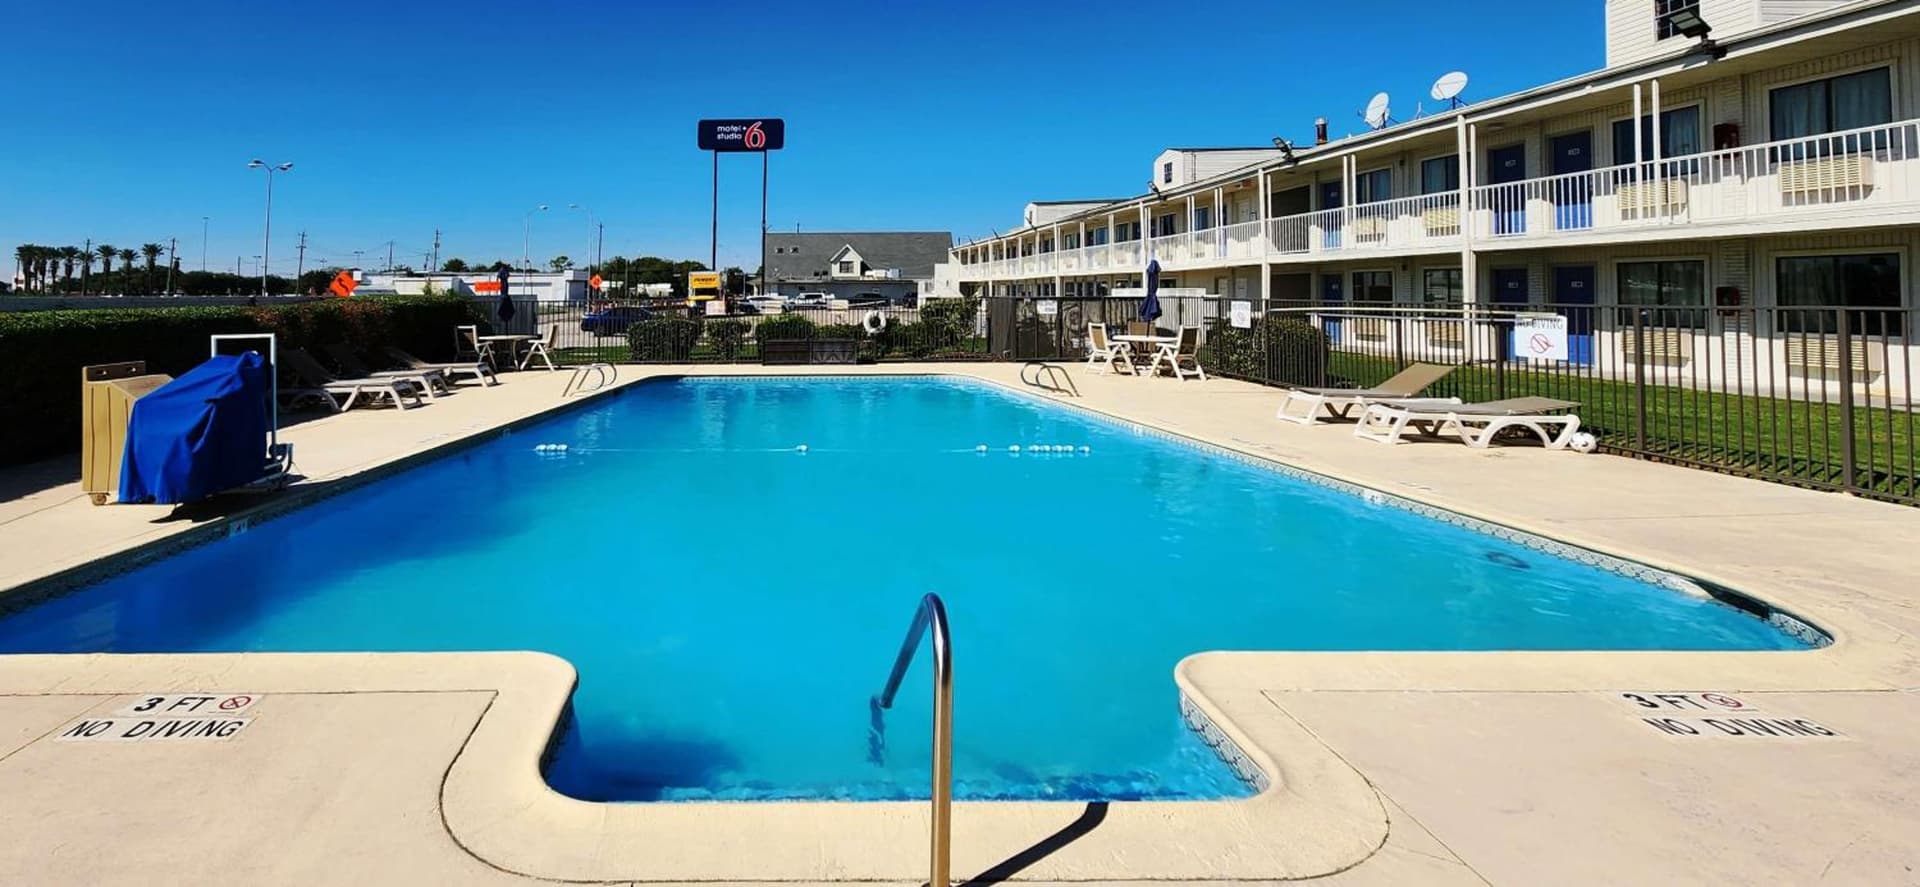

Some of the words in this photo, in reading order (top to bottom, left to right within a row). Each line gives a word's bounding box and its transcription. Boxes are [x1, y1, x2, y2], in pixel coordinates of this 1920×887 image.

[744, 121, 766, 149] 6
[134, 697, 165, 712] 3
[167, 697, 216, 712] FT
[1622, 693, 1660, 709] 3
[1653, 694, 1708, 710] FT
[62, 720, 115, 737] NO
[121, 720, 244, 738] DIVING
[1641, 718, 1700, 736] NO
[1701, 718, 1836, 737] DIVING
